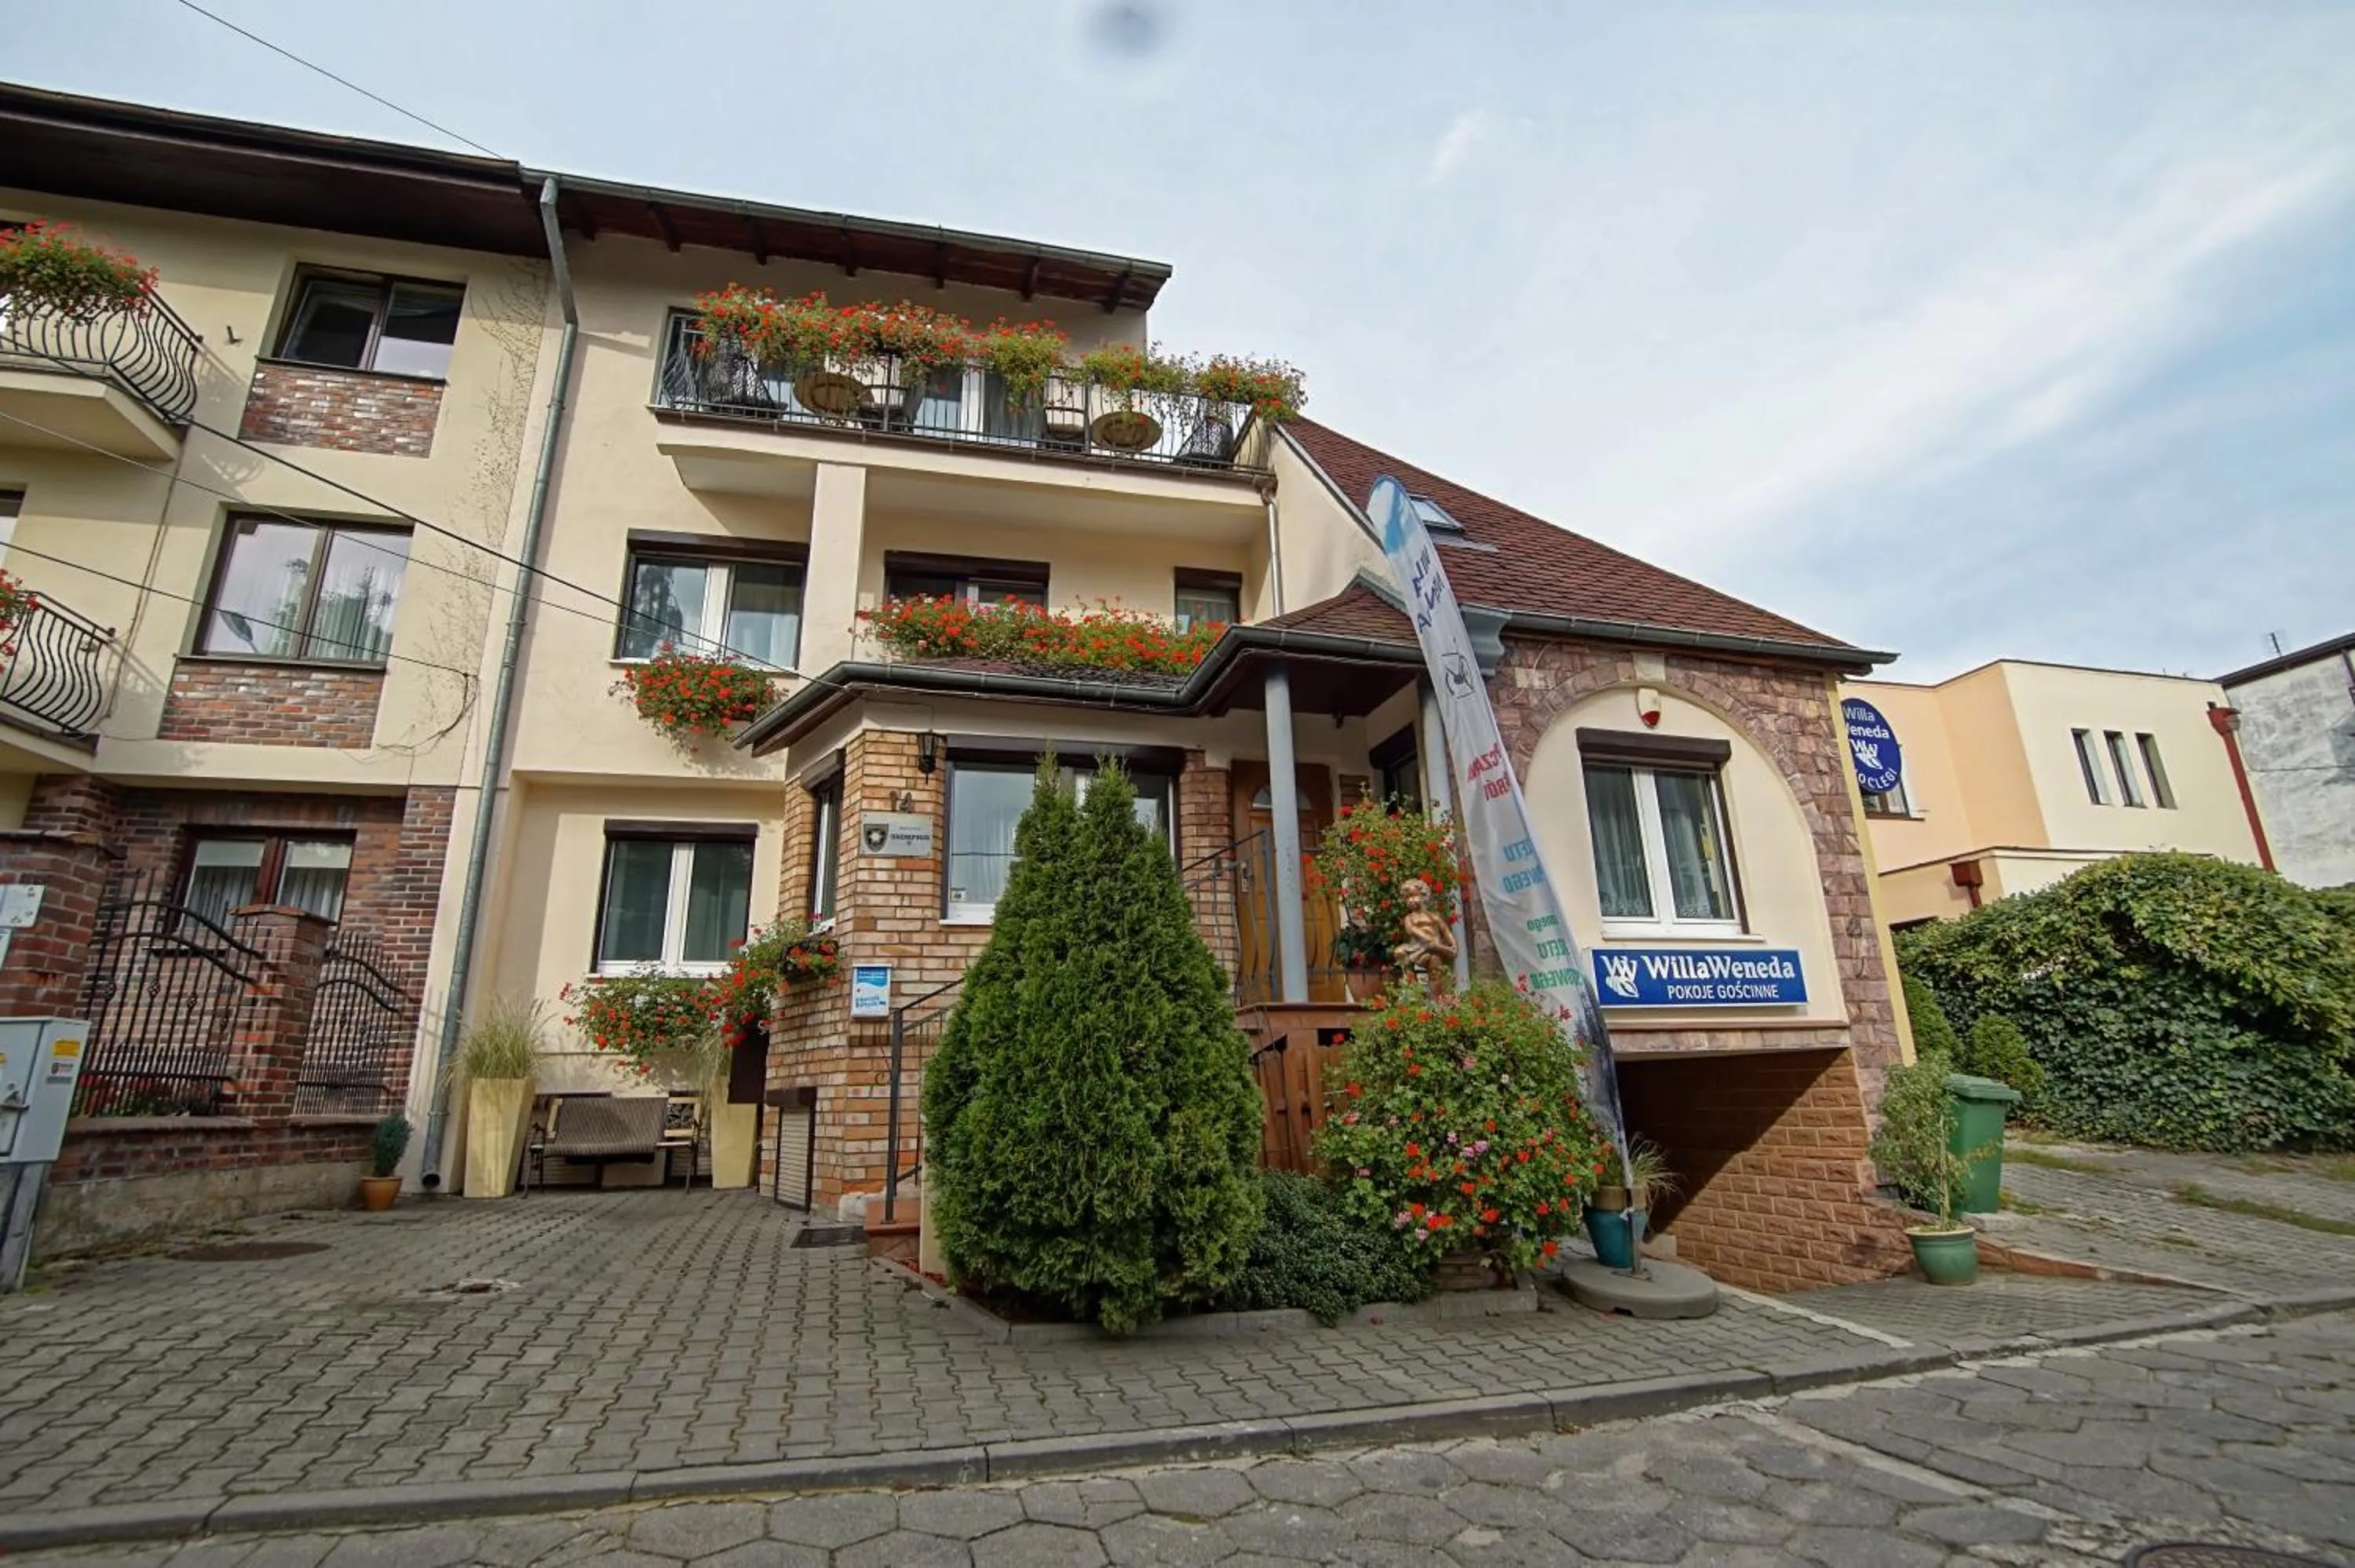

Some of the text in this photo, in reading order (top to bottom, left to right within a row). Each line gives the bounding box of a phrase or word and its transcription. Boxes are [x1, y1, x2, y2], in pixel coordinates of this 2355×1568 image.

[1846, 724, 1889, 738] eneda
[1855, 768, 1897, 789] OCLEGI
[889, 791, 912, 813] 14
[1667, 981, 1780, 1000] POKOJE GOŚCINNE
